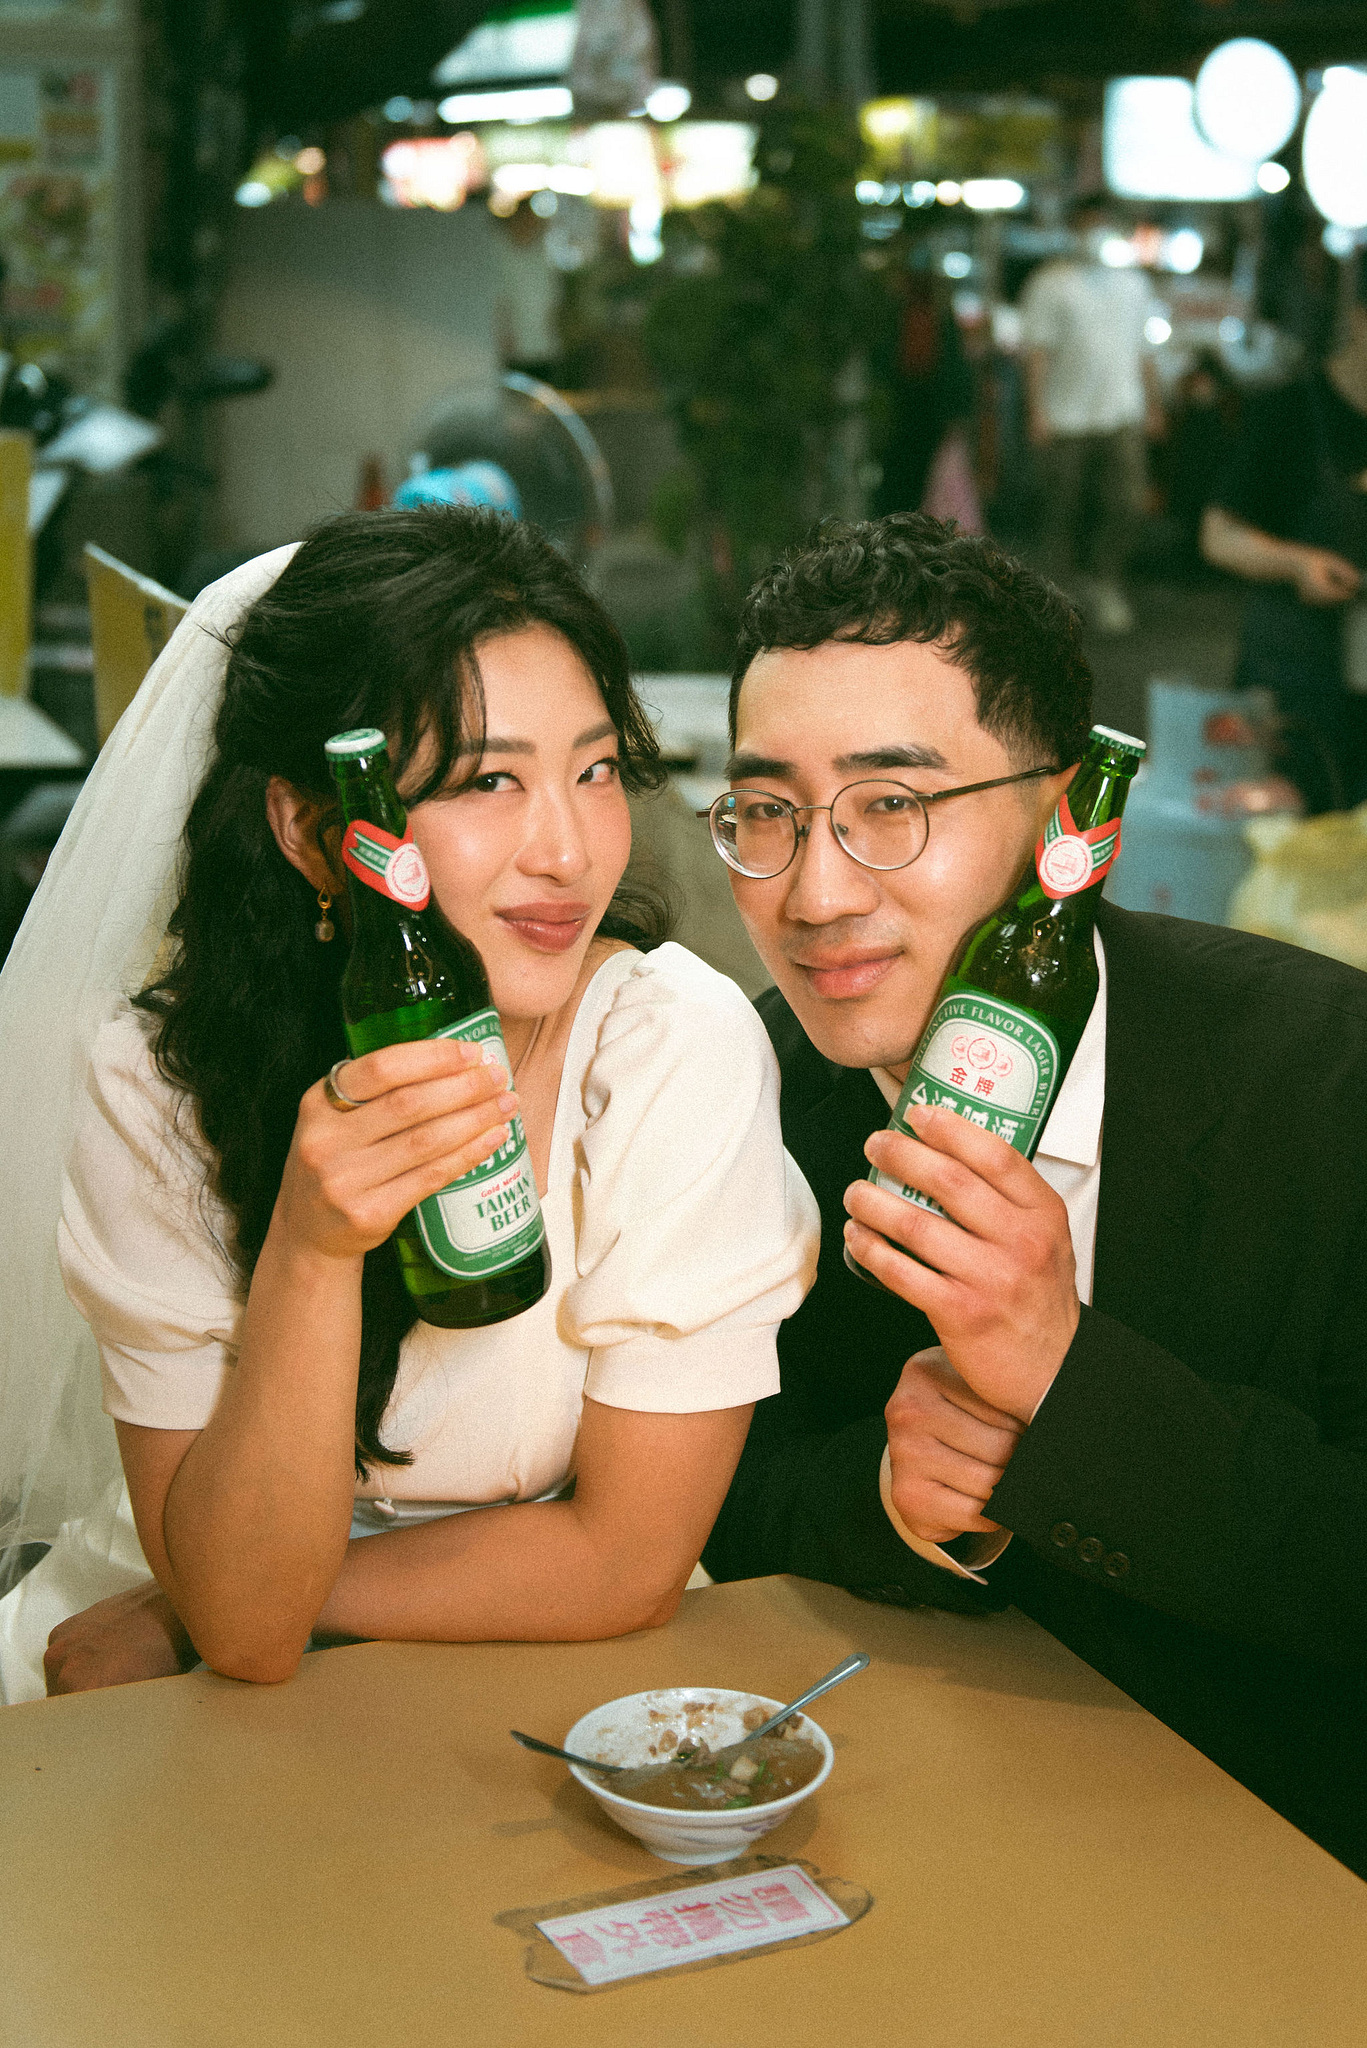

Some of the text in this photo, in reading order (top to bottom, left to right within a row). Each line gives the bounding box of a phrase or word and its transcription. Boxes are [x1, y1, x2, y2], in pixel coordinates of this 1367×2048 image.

[971, 1006, 1024, 1037] FLAVOR
[1025, 1034, 1050, 1076] LAGER
[950, 1067, 995, 1097] 金牌
[1030, 1082, 1049, 1116] BEER
[474, 1175, 530, 1218] TAIWAN
[481, 1184, 500, 1198] Gold
[491, 1195, 531, 1231] BEER
